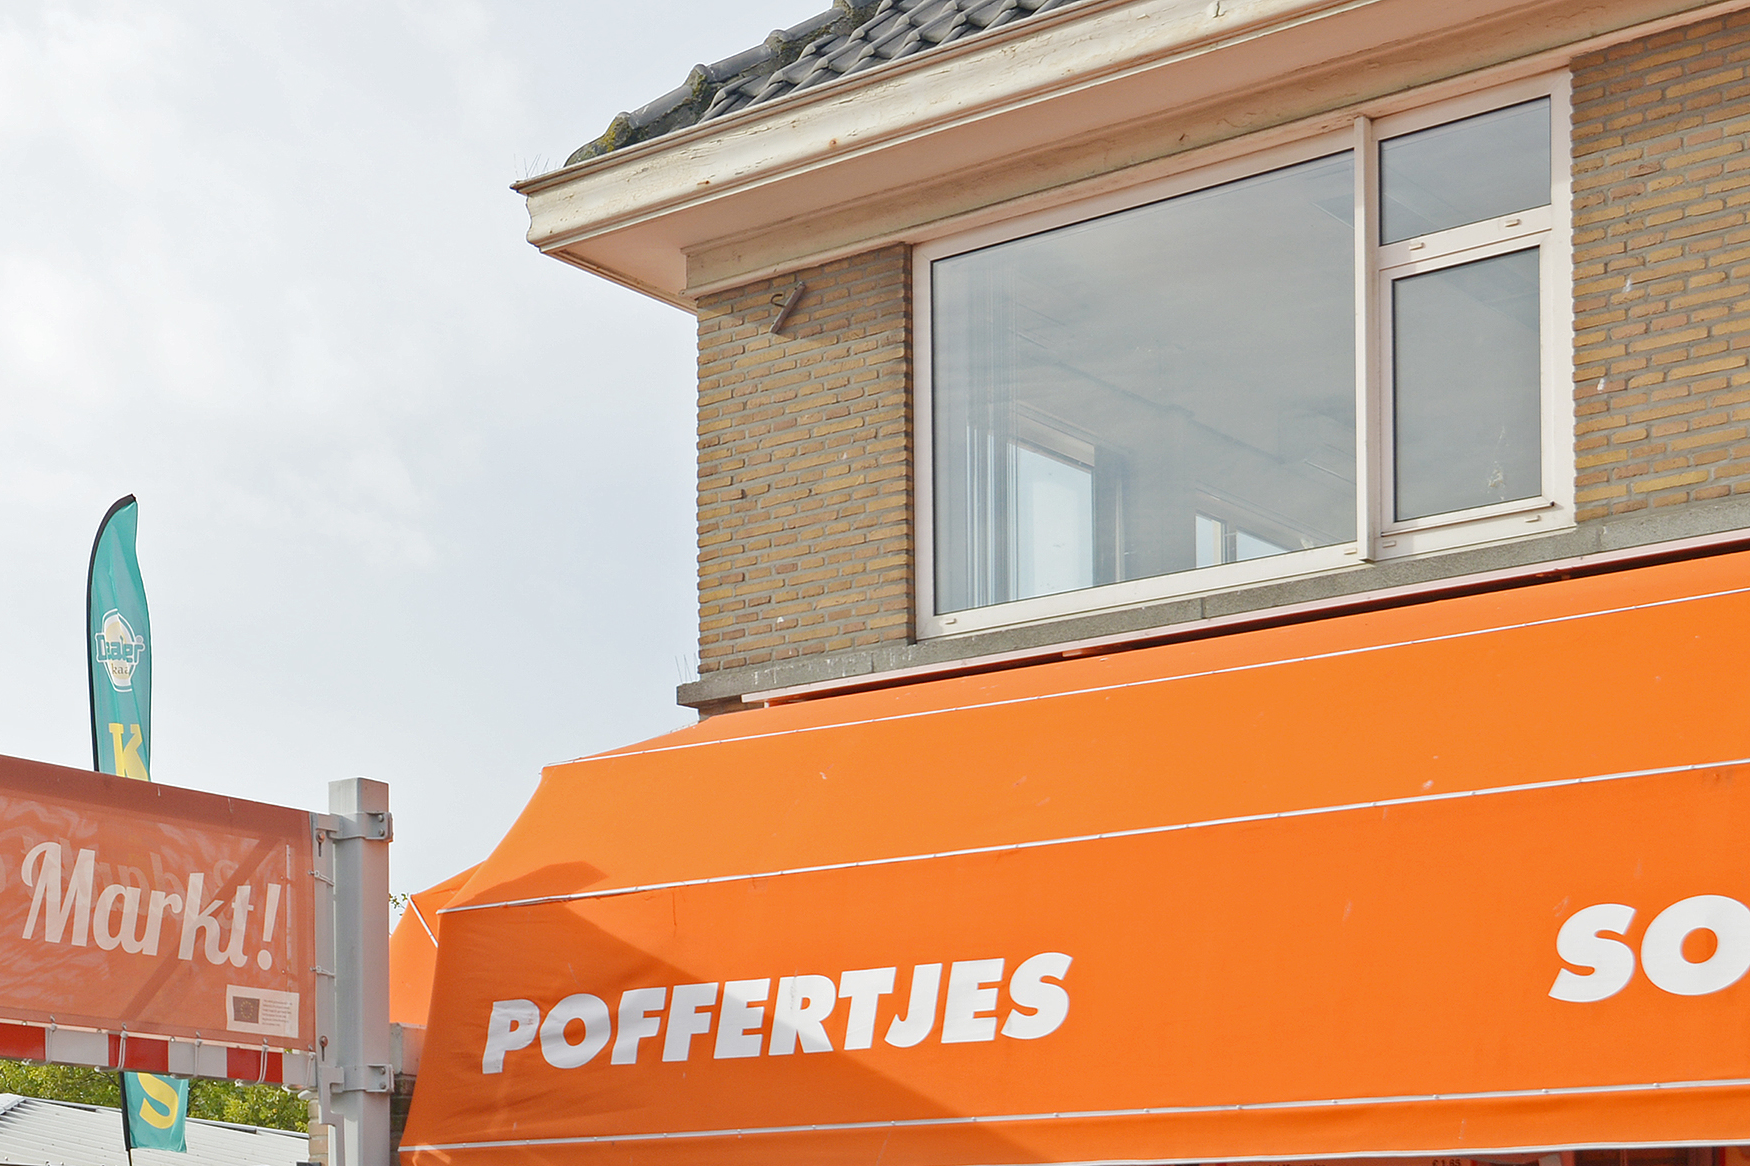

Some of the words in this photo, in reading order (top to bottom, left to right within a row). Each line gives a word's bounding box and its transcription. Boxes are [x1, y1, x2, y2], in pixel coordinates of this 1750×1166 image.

[21, 841, 282, 971] Markt!
[1547, 894, 1750, 1003] SO
[481, 952, 1074, 1075] POFFERTJES
